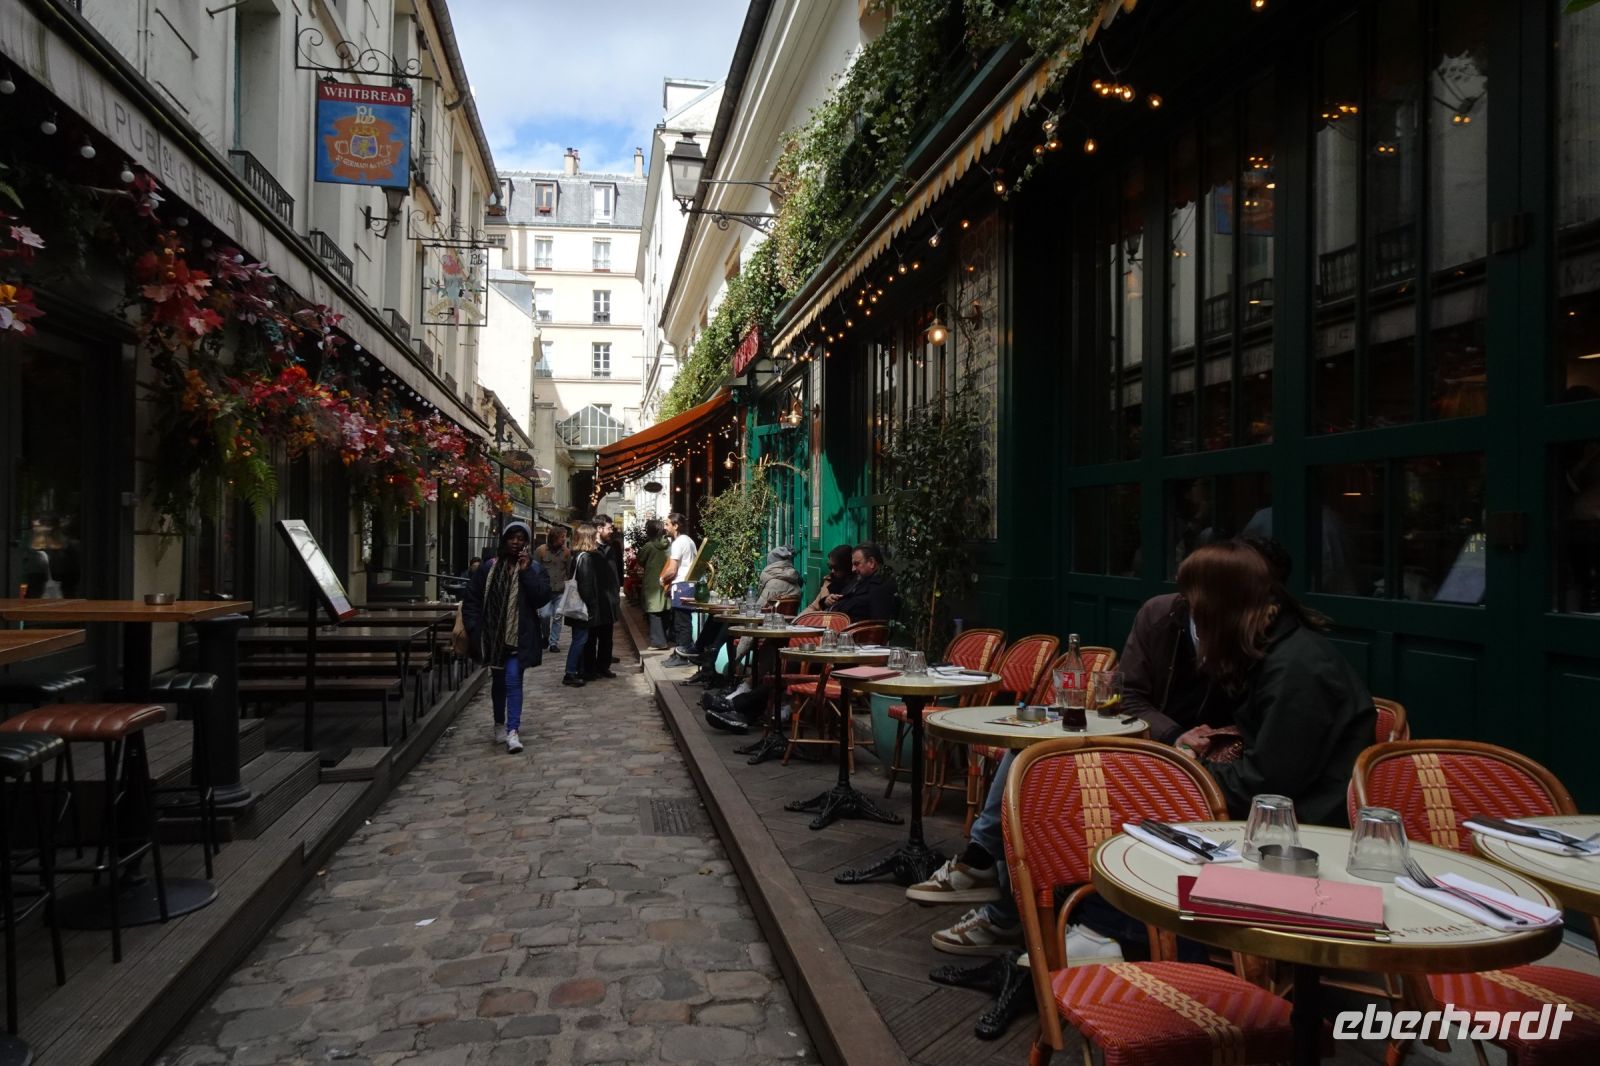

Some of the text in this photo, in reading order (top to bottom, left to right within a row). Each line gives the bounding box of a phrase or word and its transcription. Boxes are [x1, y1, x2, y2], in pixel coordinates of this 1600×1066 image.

[323, 86, 407, 103] WHITBREAD
[354, 105, 377, 125] Pub
[114, 102, 157, 165] PUB
[470, 253, 483, 266] Pub
